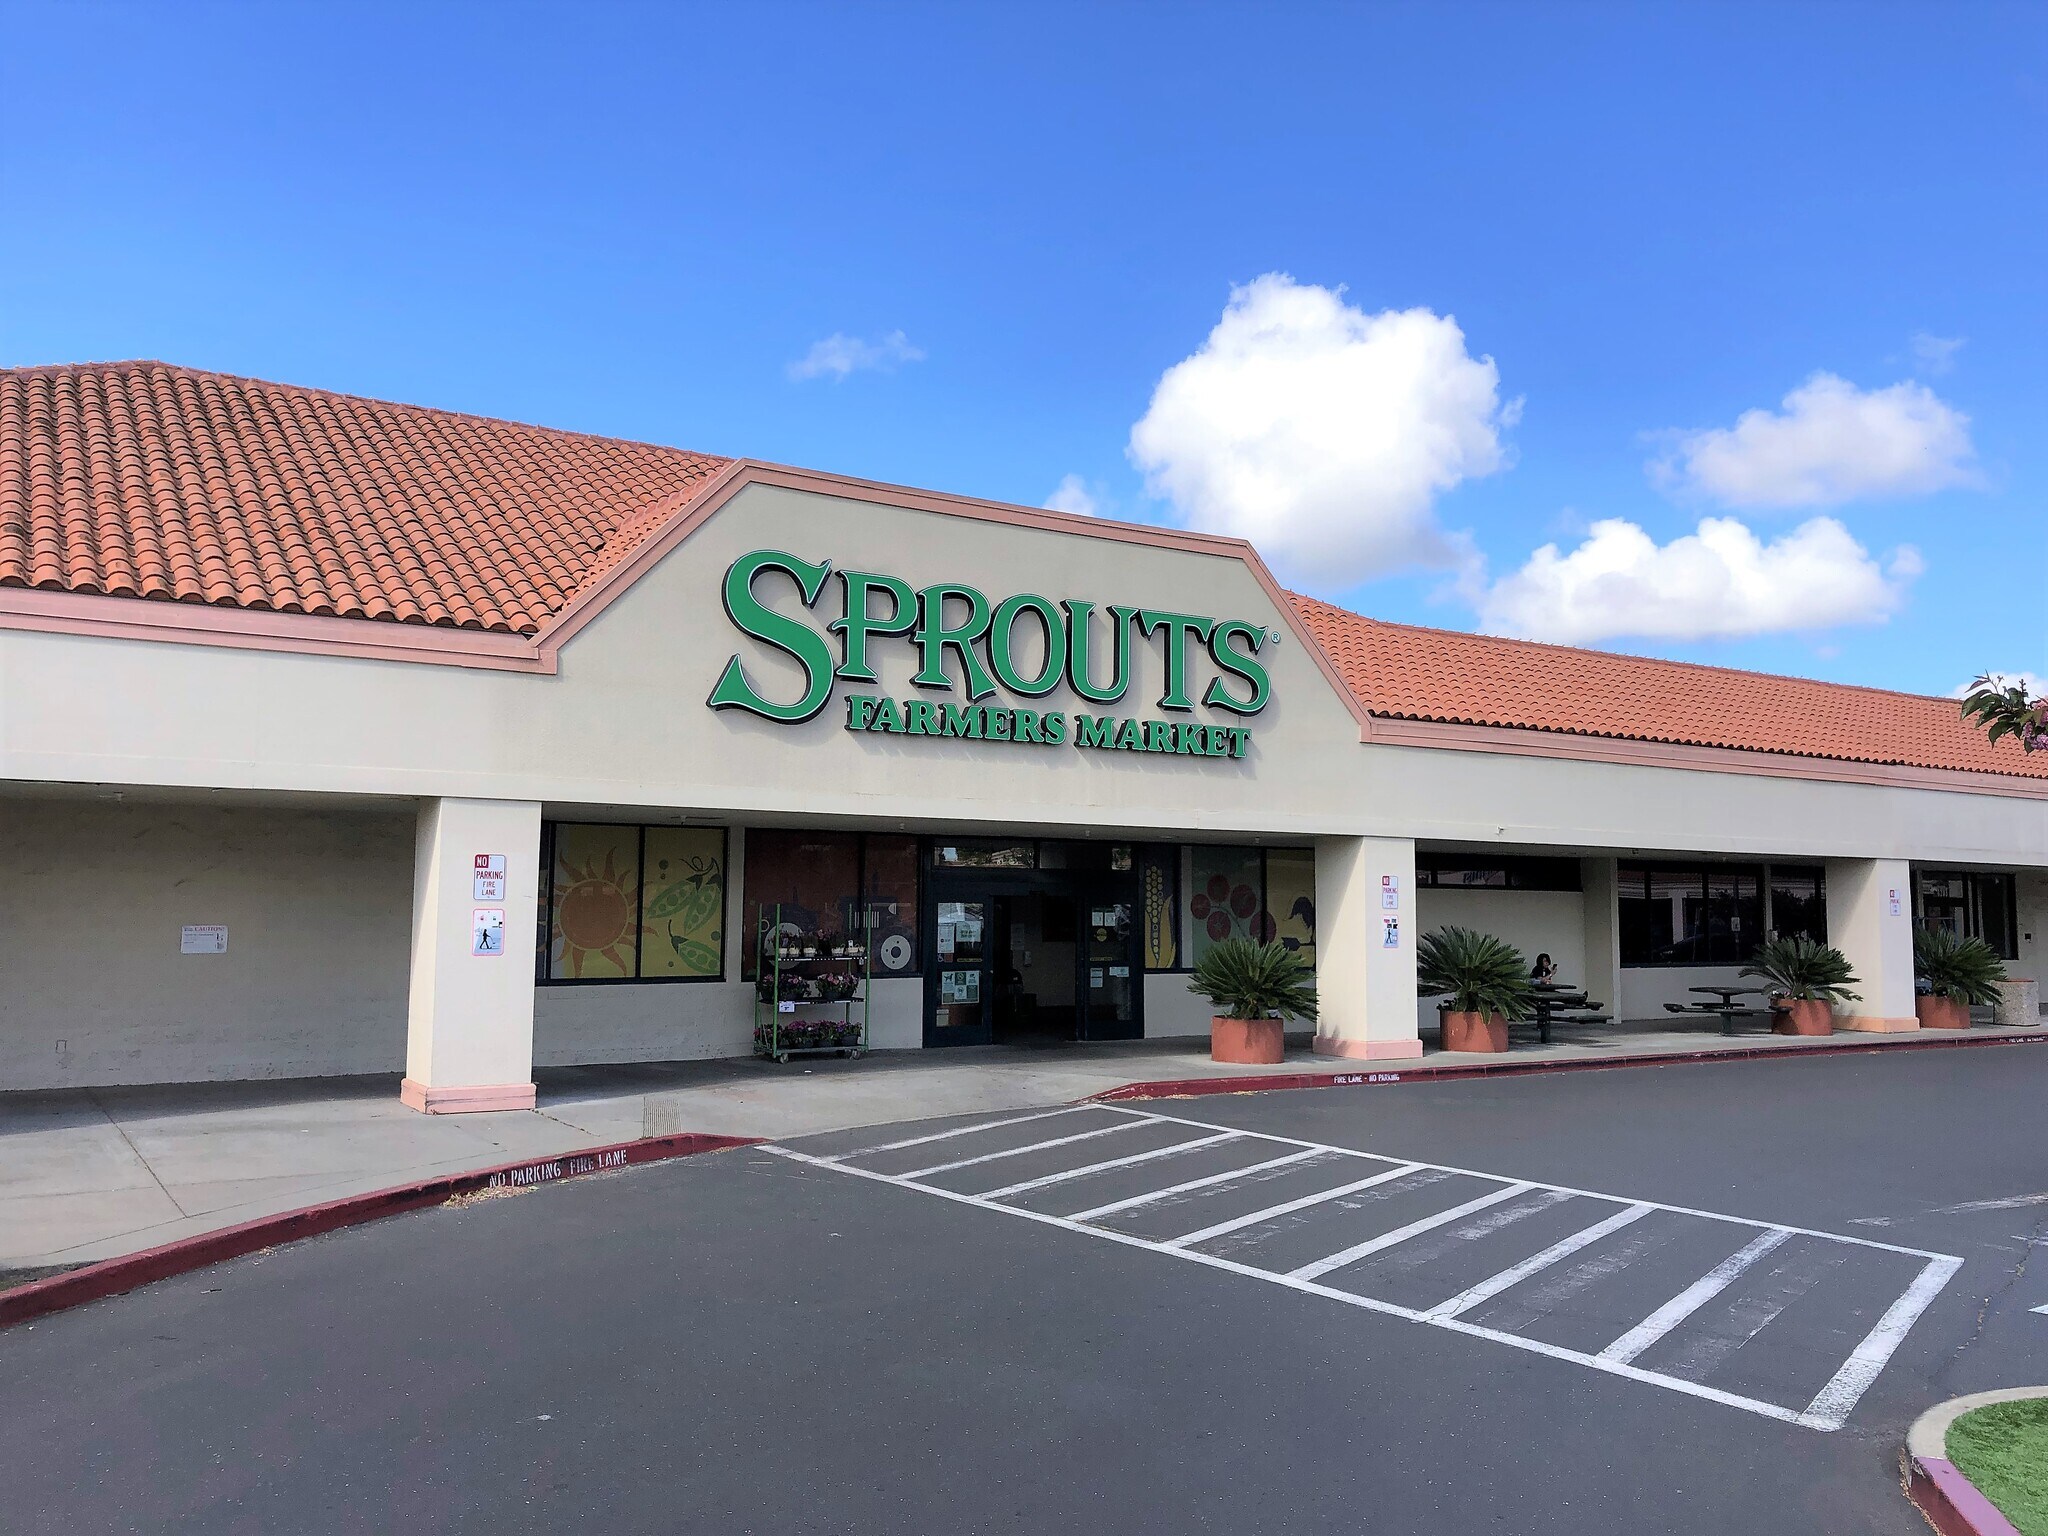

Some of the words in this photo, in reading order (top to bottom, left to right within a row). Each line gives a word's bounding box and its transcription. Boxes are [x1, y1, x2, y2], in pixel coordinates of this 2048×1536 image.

[708, 549, 1273, 725] SPROUTS
[844, 694, 1067, 745] FARMERS
[1073, 714, 1253, 758] MARKET
[476, 856, 488, 866] NO
[476, 870, 503, 880] PARKING
[489, 1172, 506, 1188] NO
[511, 1162, 562, 1187] PARKING
[570, 1157, 594, 1175] FIRE
[598, 1149, 627, 1168] LANE
